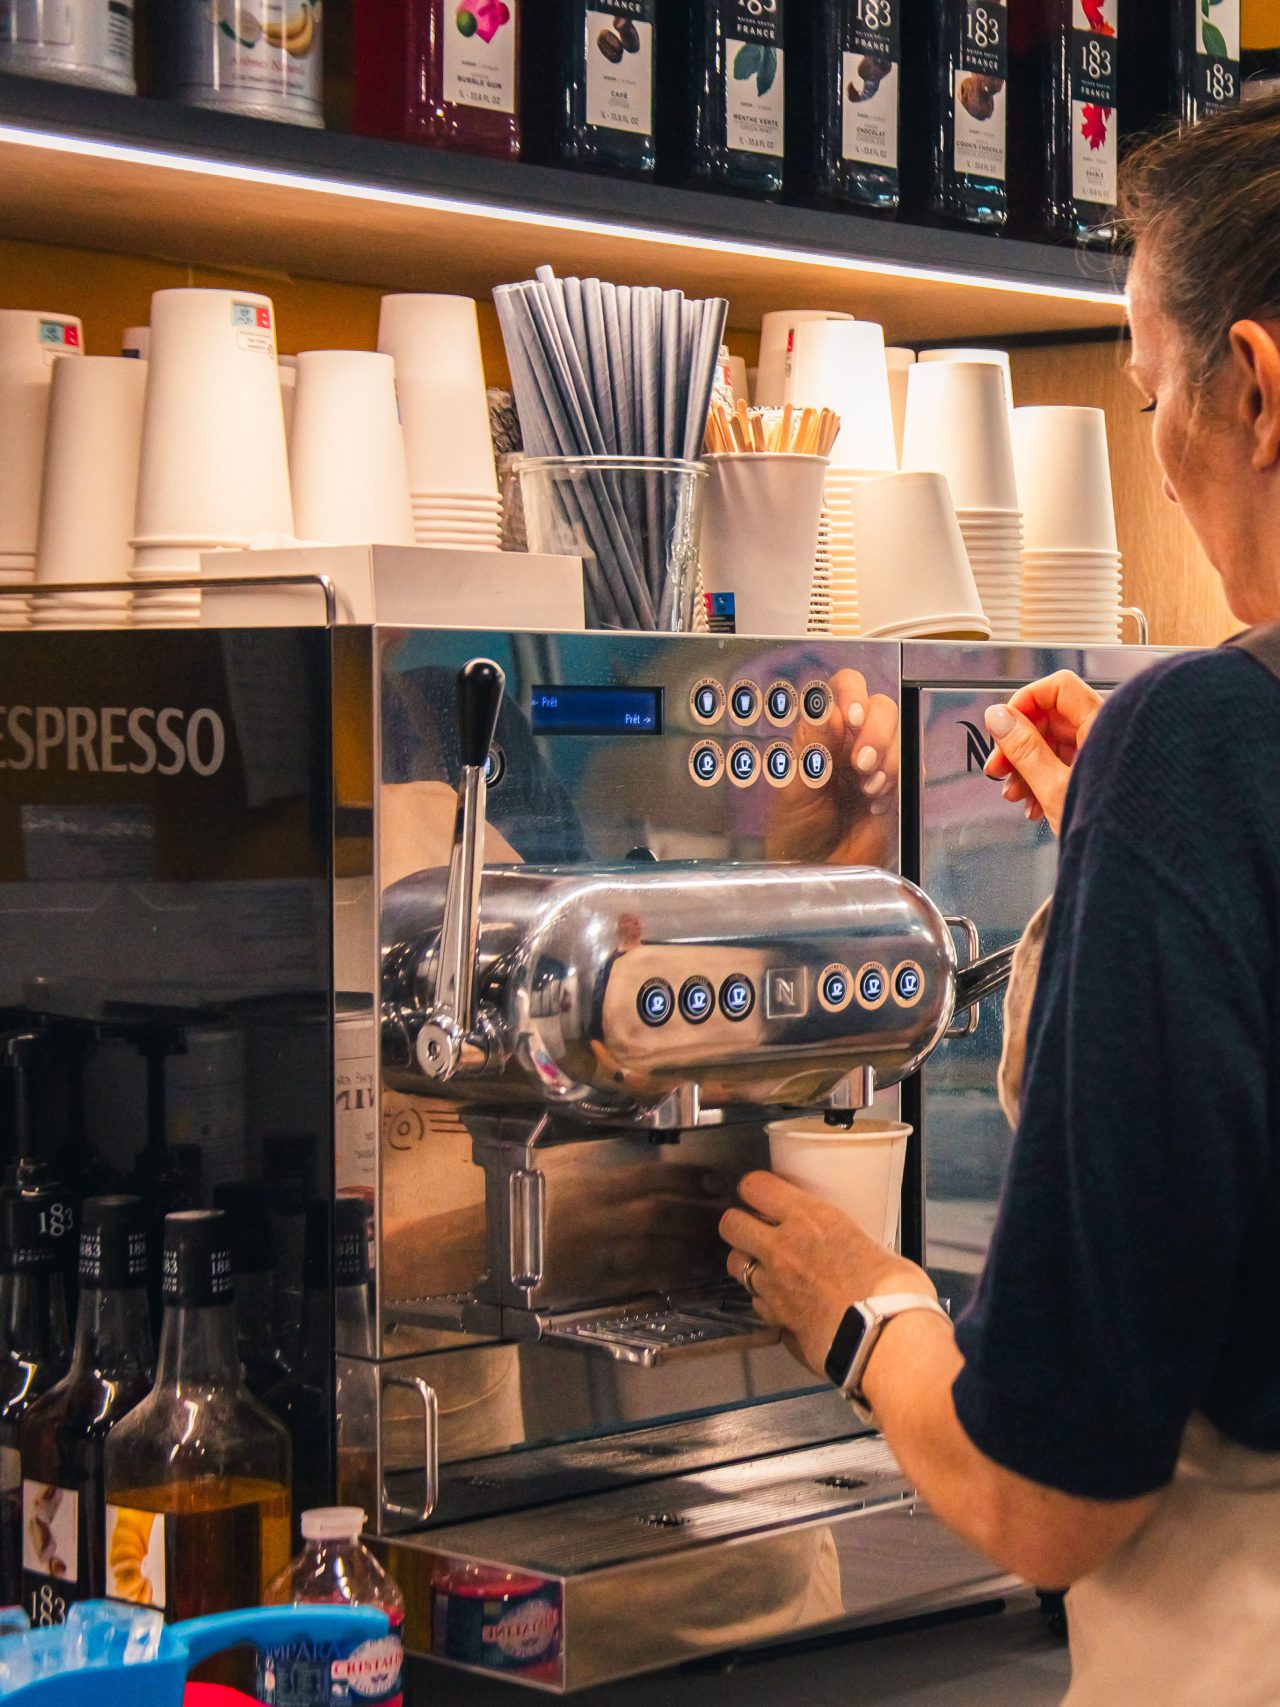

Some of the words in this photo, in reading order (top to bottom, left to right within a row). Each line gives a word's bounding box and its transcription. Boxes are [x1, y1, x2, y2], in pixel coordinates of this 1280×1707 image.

[736, 23, 775, 40] FRANCE
[855, 37, 890, 54] FRANCE
[966, 55, 998, 71] FRANCE
[457, 75, 485, 87] BUBBLE
[486, 80, 503, 90] GUM
[1081, 86, 1111, 100] FRANCE
